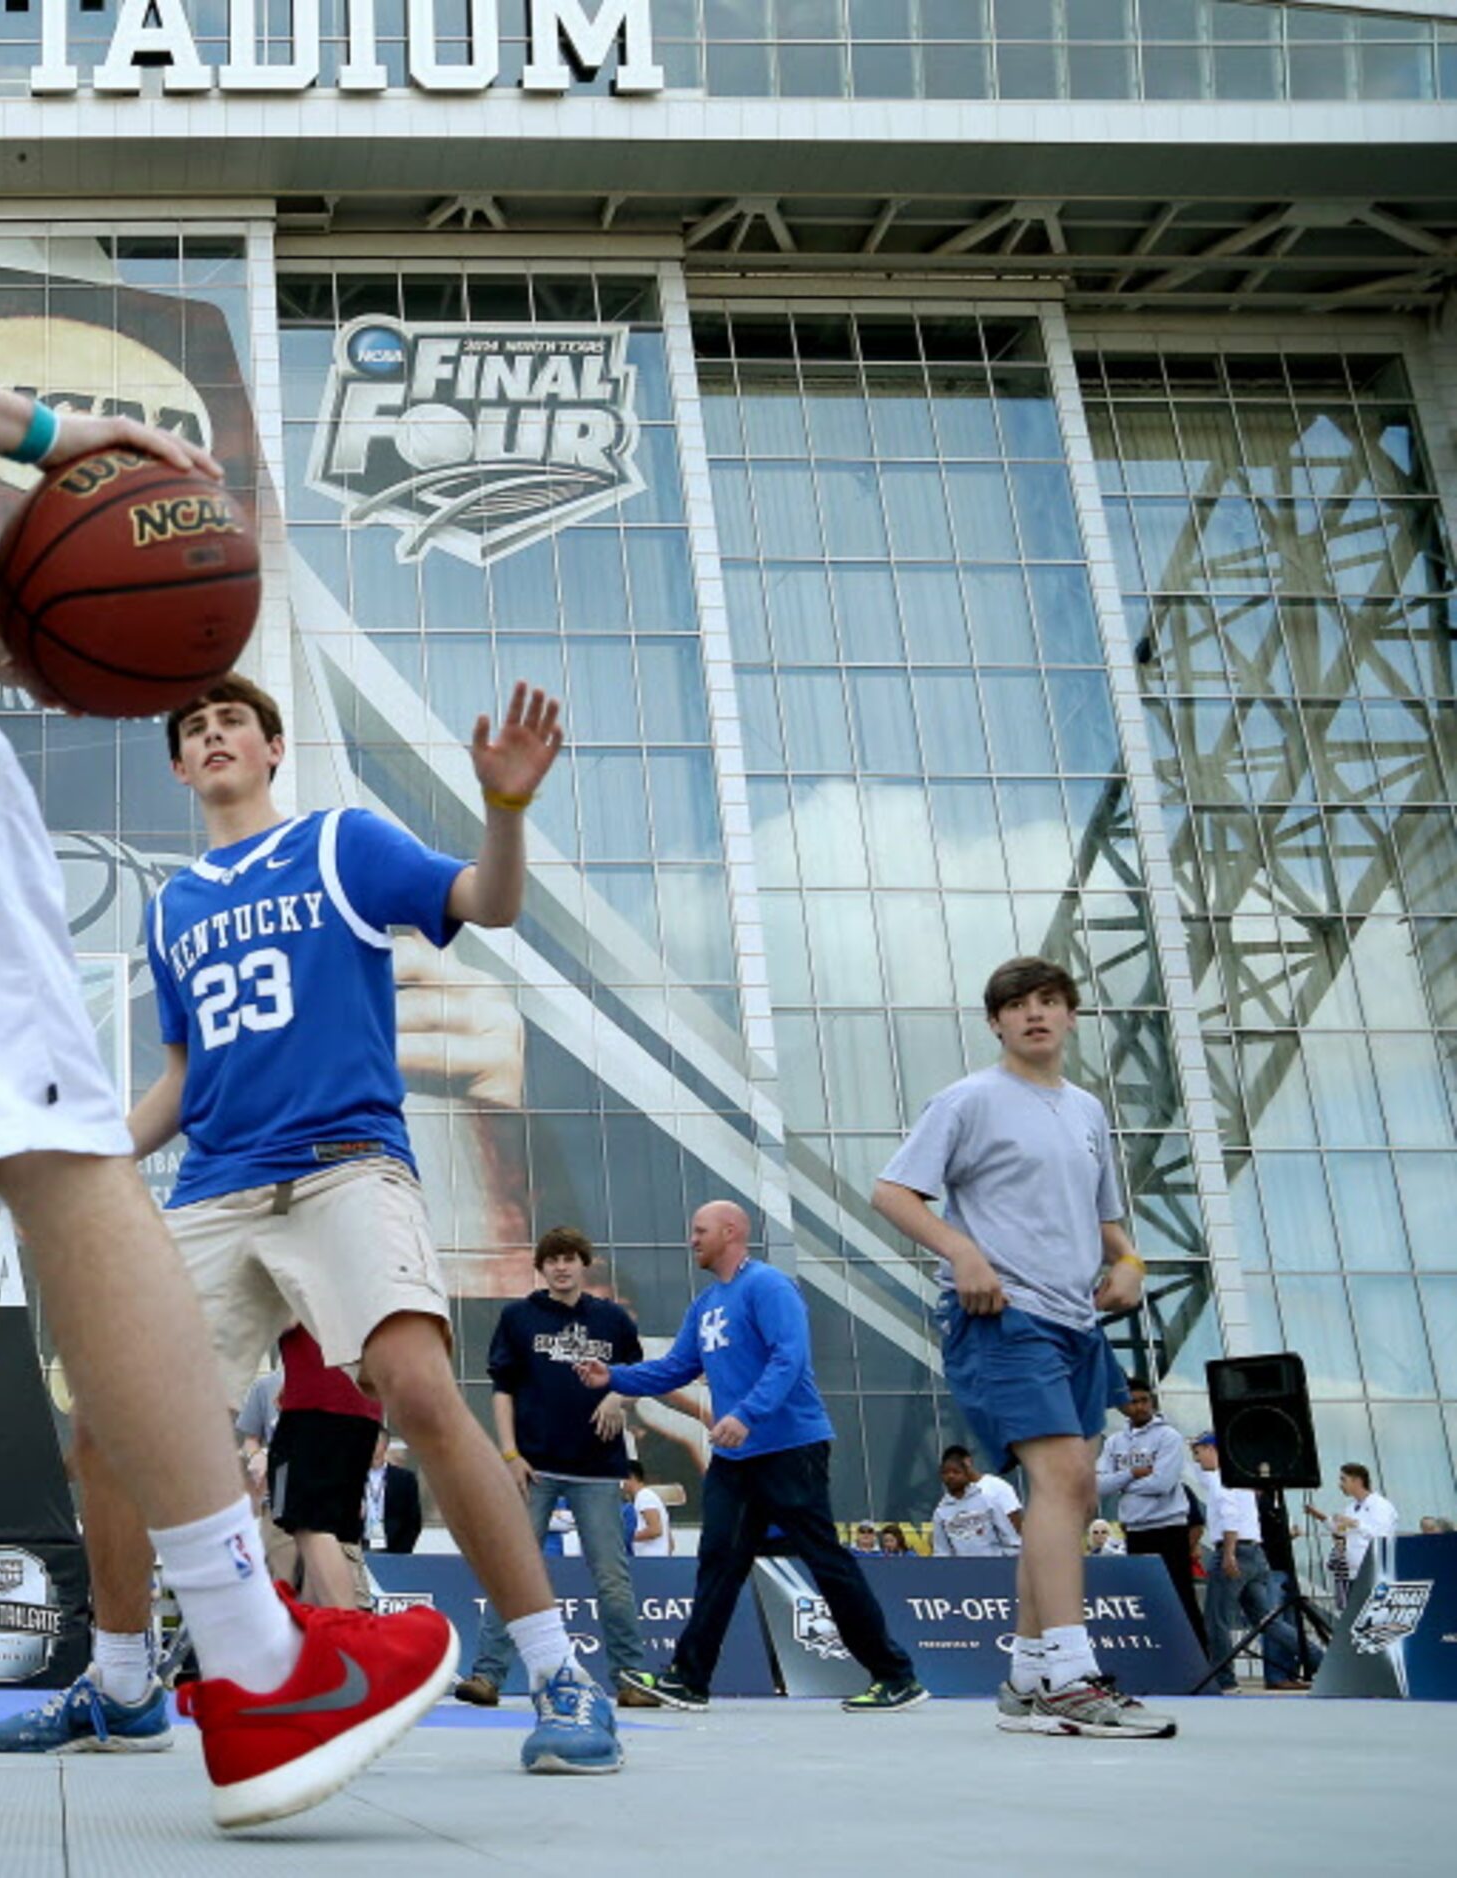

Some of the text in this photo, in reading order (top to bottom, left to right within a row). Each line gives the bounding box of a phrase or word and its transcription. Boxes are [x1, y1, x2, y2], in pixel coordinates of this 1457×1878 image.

[357, 349, 403, 362] NCAA
[411, 338, 614, 400] FINAL
[329, 383, 618, 476] FOUR
[169, 891, 324, 982] KENTUCKY
[191, 947, 295, 1051] 23
[907, 1597, 1012, 1620] TIP-OFF
